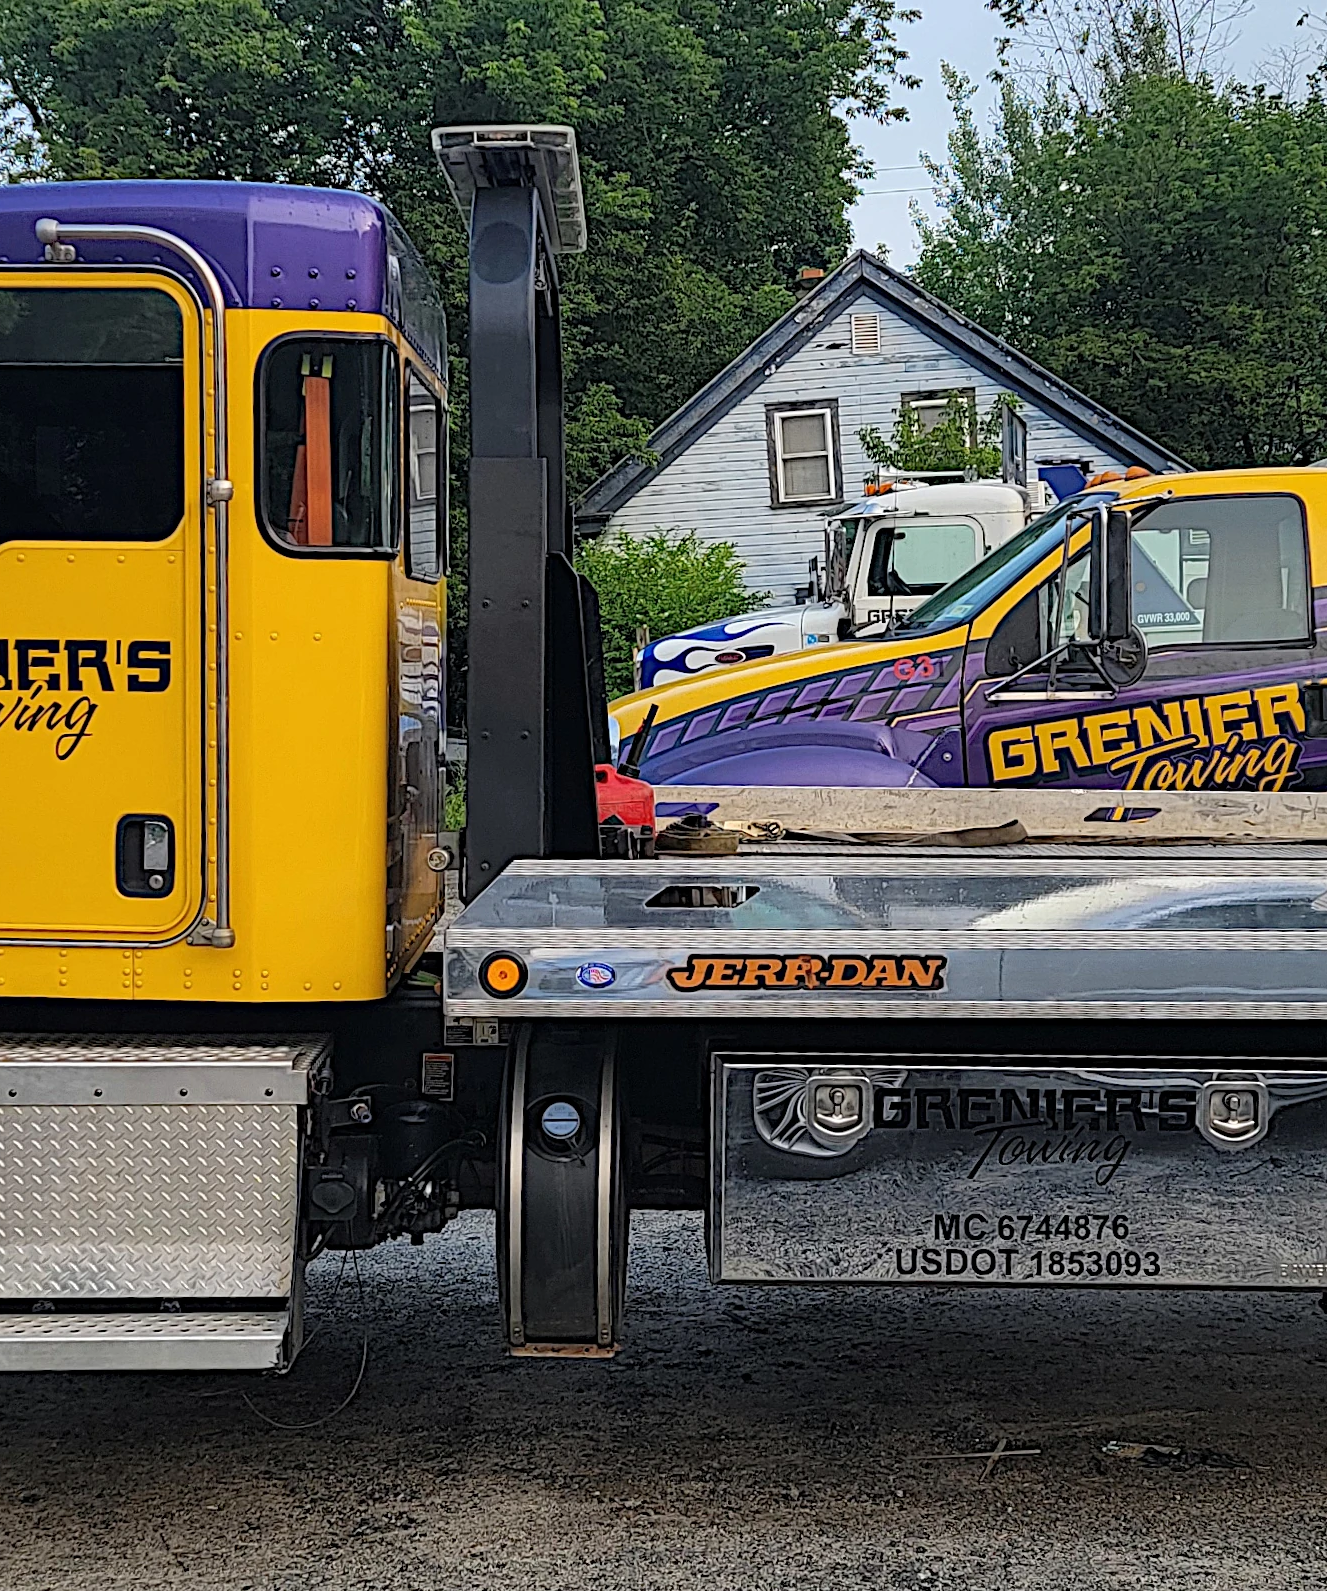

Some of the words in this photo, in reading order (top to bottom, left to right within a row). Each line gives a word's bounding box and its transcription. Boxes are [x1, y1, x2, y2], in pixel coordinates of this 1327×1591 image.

[1137, 612, 1163, 624] GVWR
[1164, 611, 1190, 623] 33,000
[893, 655, 935, 680] G3
[1109, 734, 1299, 792] Towing
[671, 957, 943, 988] JERR-DAN
[873, 1088, 1198, 1132] GRENIER'S
[967, 1119, 1132, 1187] Towing
[934, 1213, 989, 1241] MC
[997, 1213, 1130, 1241] 6744876
[895, 1248, 1019, 1276] USDOT
[1030, 1250, 1161, 1277] 1853093
